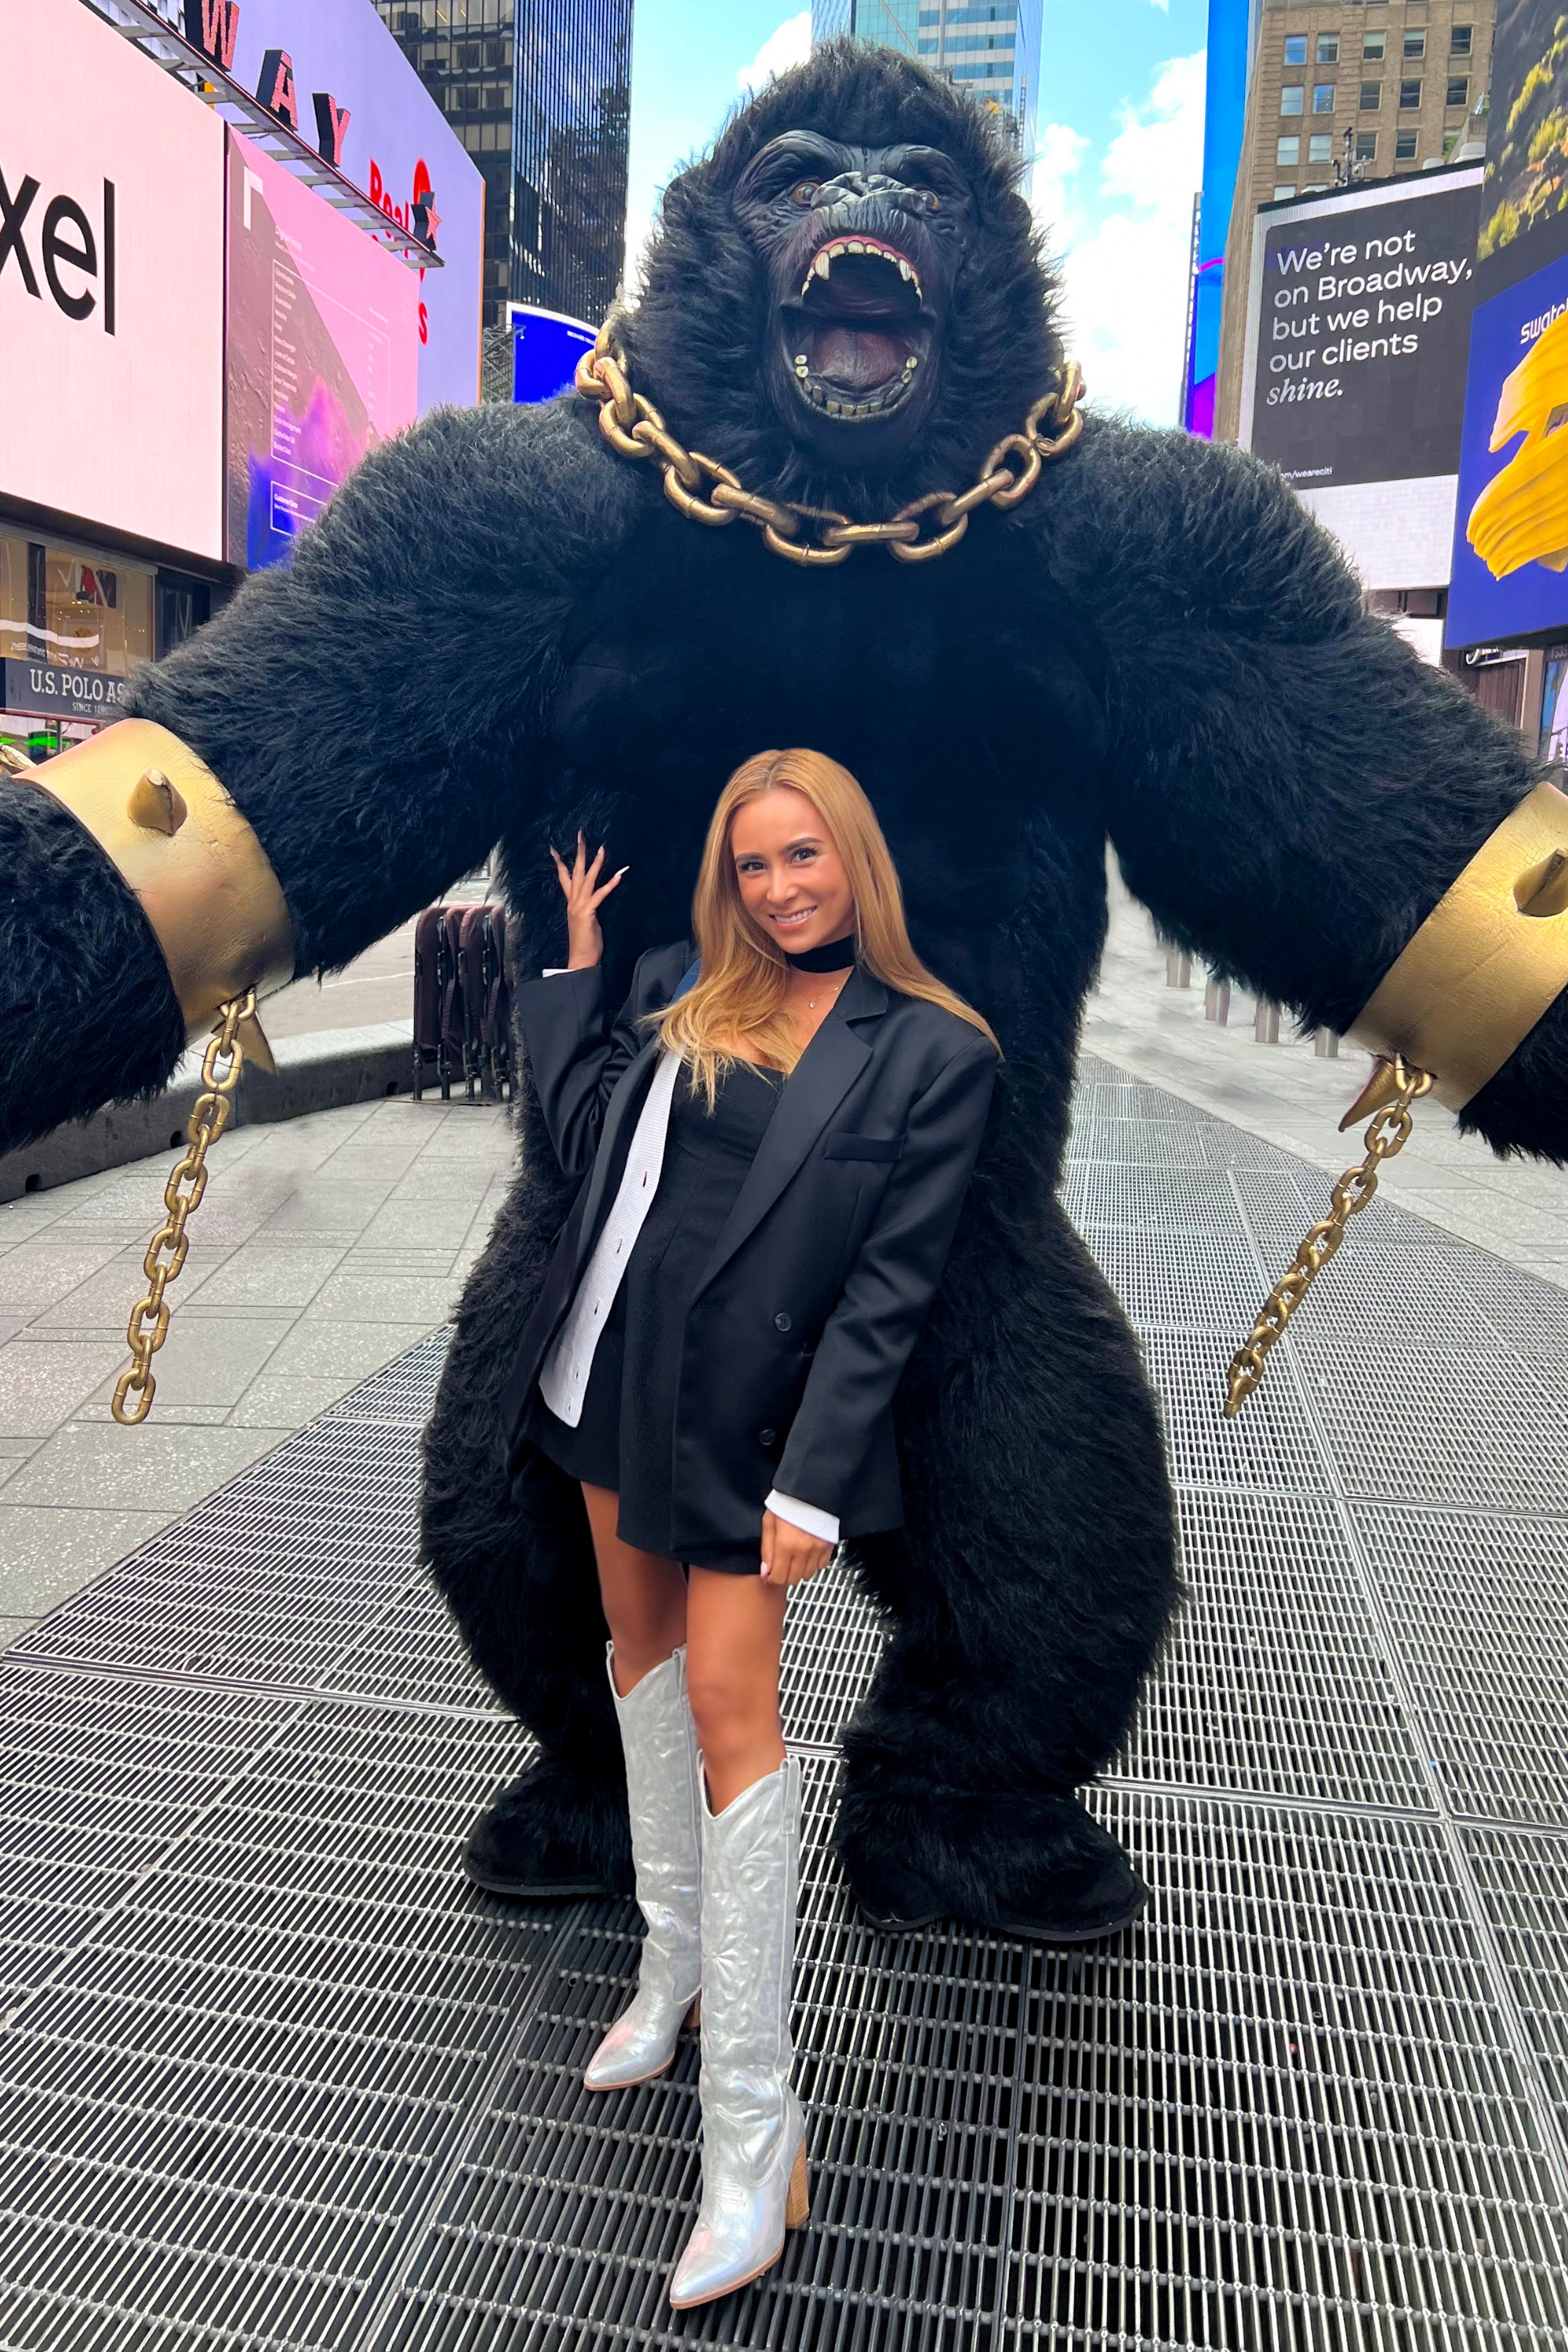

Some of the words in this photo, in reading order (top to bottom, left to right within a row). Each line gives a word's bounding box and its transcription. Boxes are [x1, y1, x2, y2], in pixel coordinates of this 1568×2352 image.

[0, 165, 116, 337] xel
[1276, 241, 1357, 275] We're
[1365, 230, 1416, 260] not
[1274, 285, 1308, 308] on
[1317, 257, 1473, 301] Broadway,
[1272, 314, 1320, 341] but
[1327, 307, 1370, 332] we
[1377, 292, 1443, 322] help
[1520, 296, 1568, 345] swatc
[1269, 349, 1316, 372] our
[1322, 332, 1418, 365] clients
[1265, 376, 1343, 406] shine.
[30, 669, 58, 695] U.S.
[61, 673, 103, 701] POLO
[72, 702, 92, 713] SINCE
